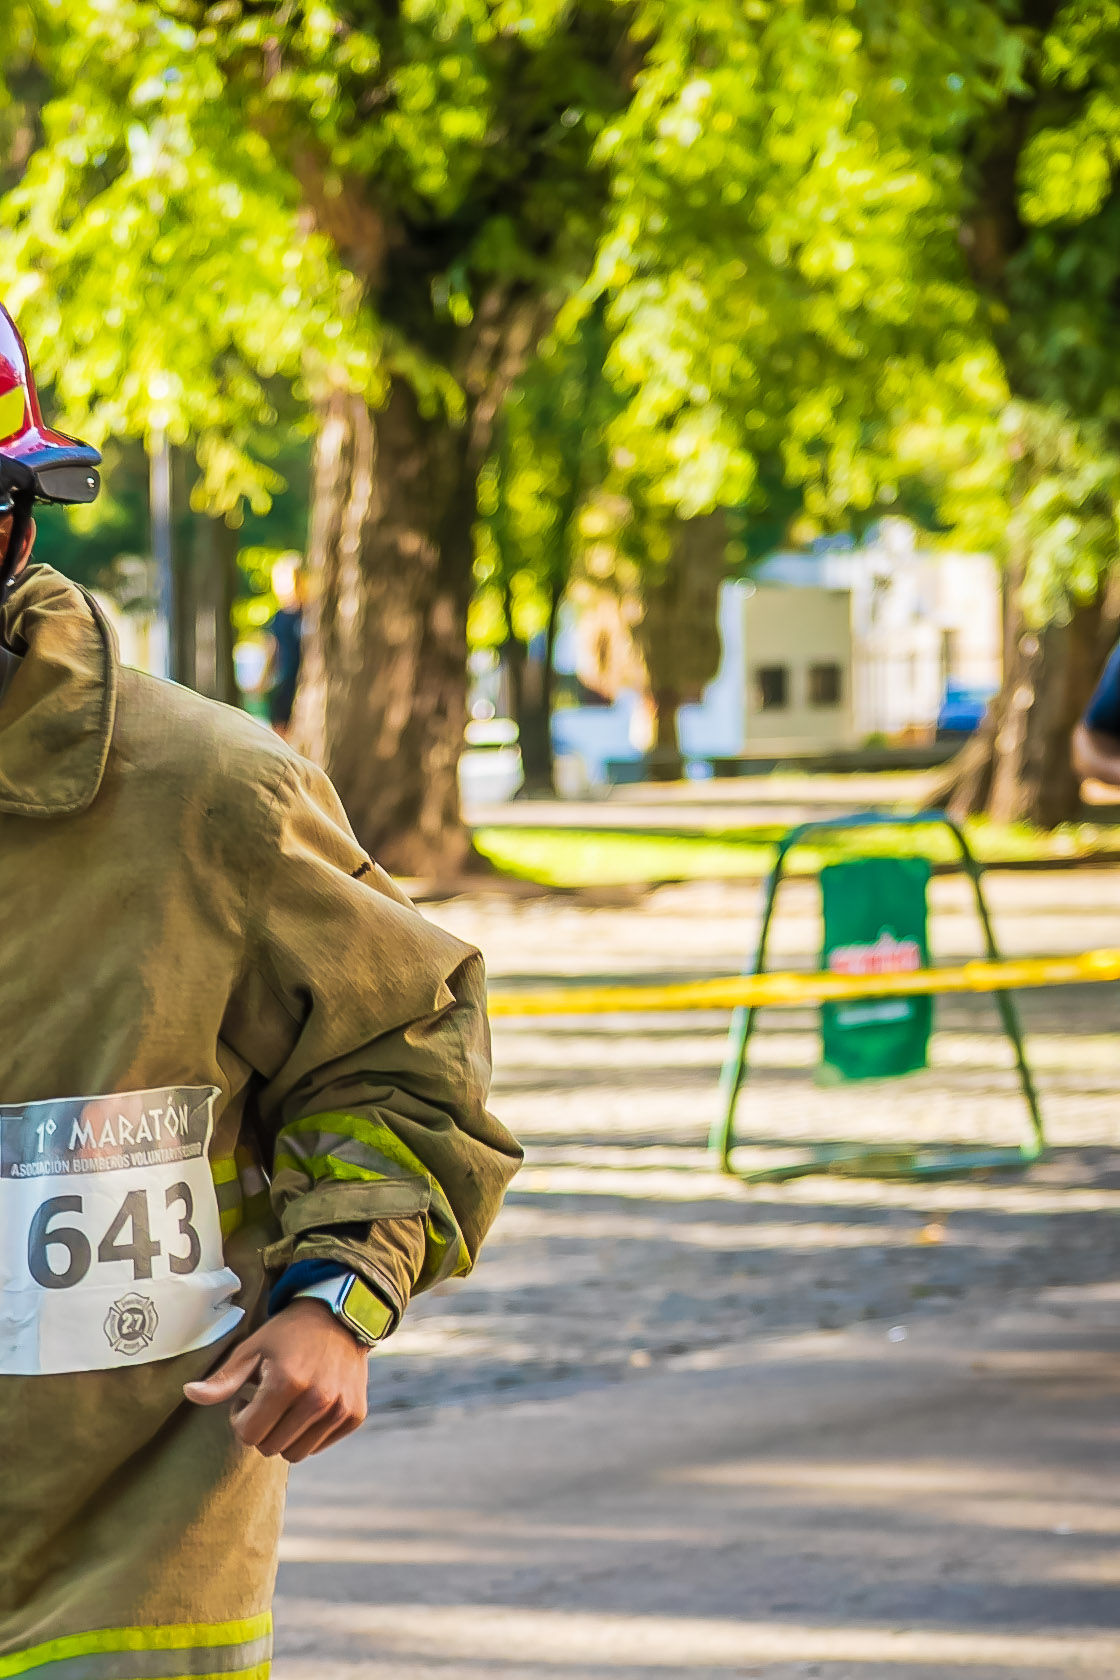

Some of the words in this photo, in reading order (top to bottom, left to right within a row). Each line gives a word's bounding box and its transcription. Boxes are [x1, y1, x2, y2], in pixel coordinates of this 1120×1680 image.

[68, 1095, 189, 1151] MARATÓN
[27, 1181, 202, 1290] 643
[121, 1311, 144, 1335] 27
